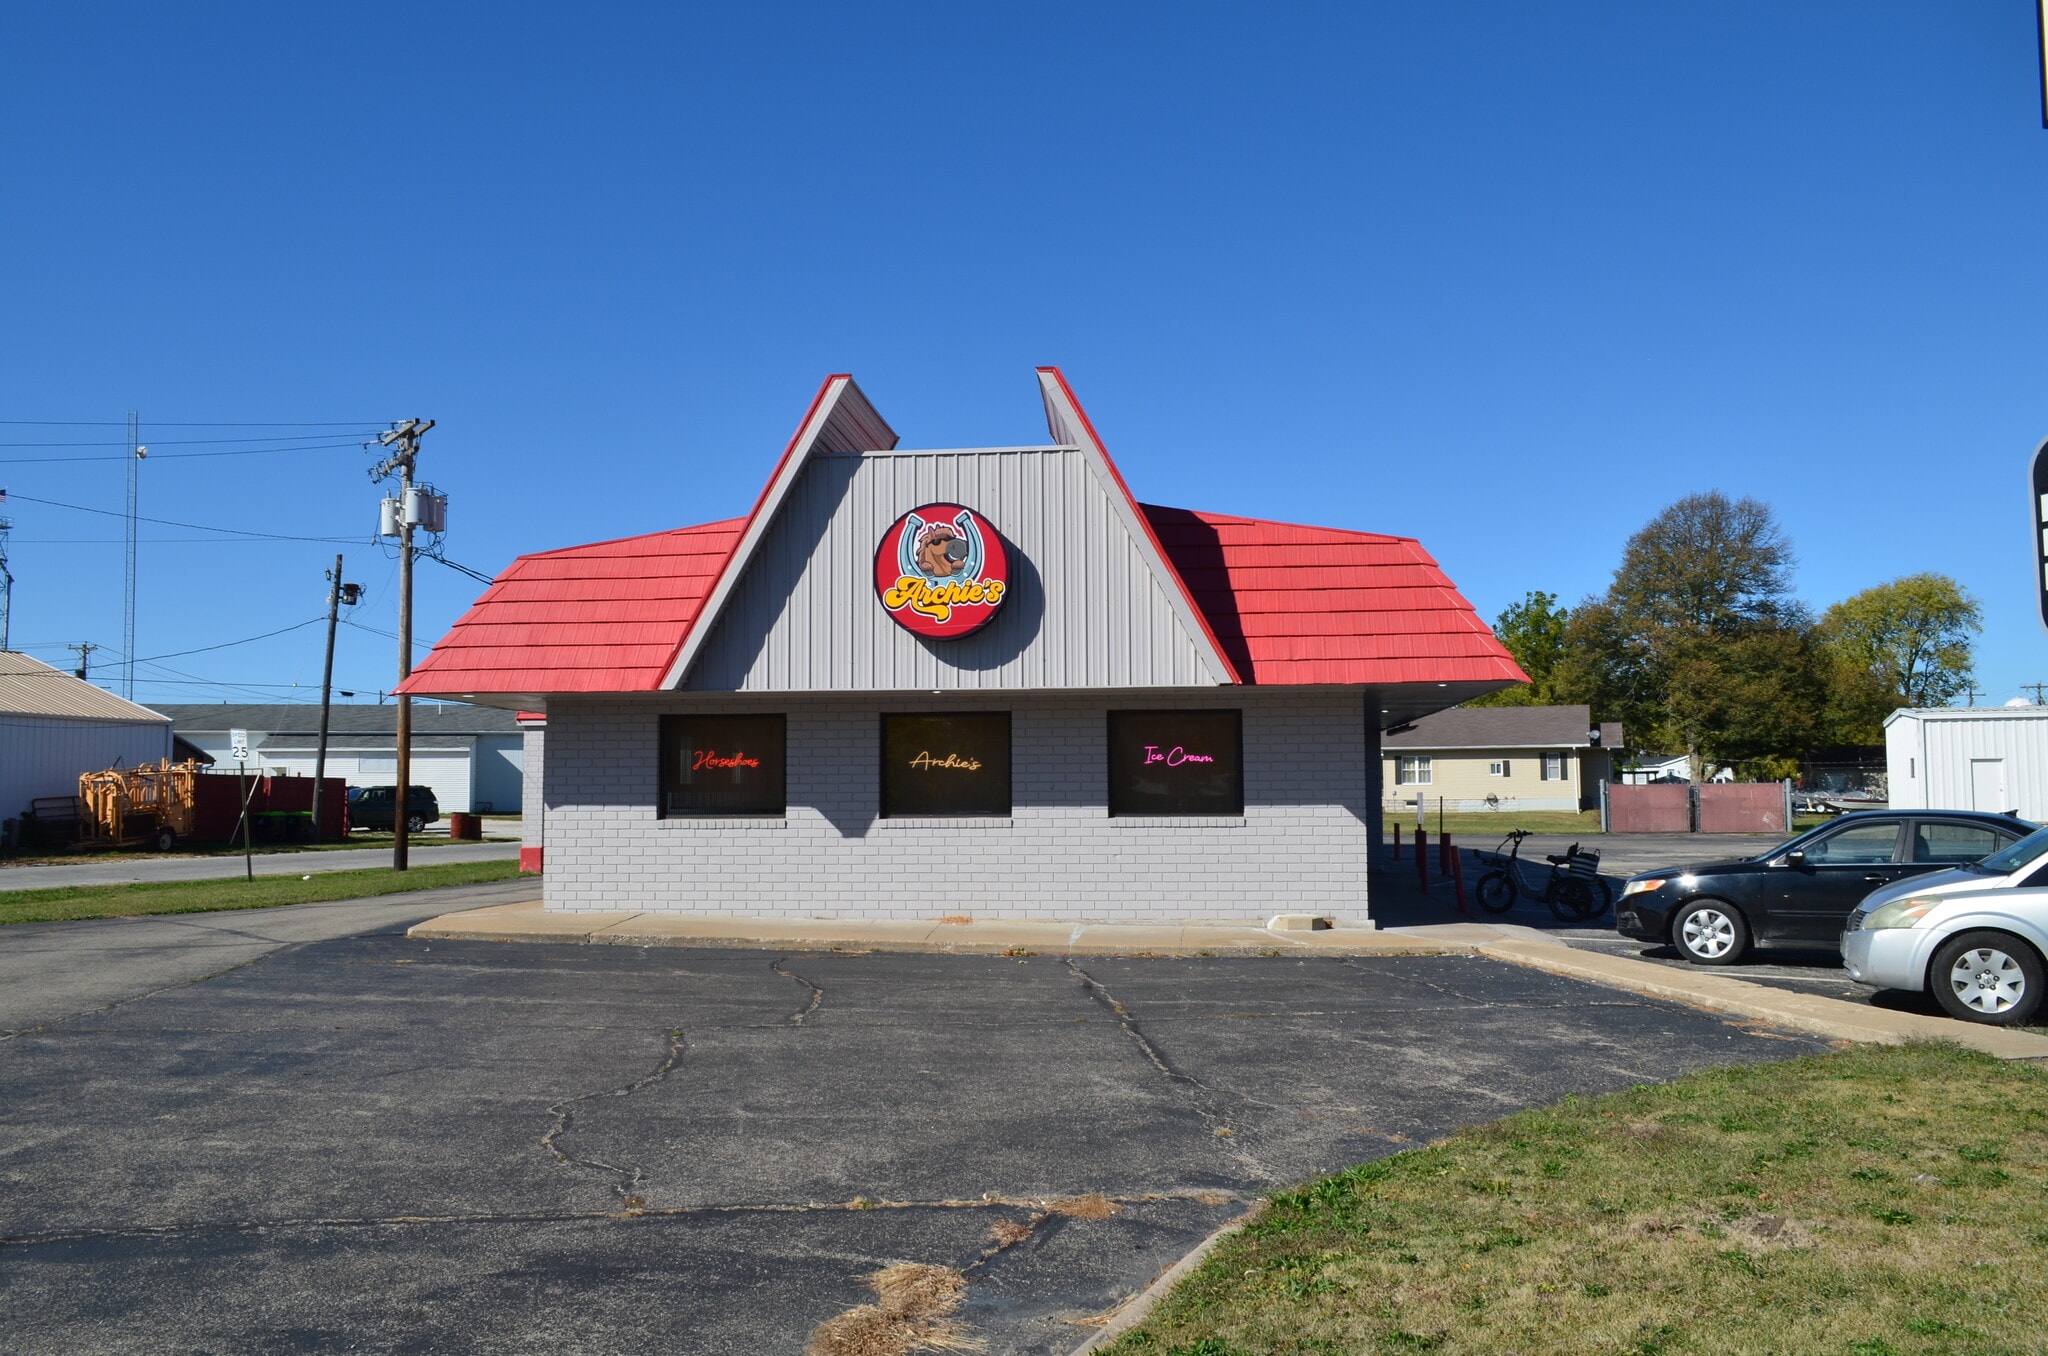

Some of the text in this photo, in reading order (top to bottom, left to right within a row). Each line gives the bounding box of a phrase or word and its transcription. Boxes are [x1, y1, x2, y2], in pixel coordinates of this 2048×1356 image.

[884, 575, 1005, 622] Archie's
[233, 746, 248, 758] 25
[693, 750, 759, 770] Horseshoes
[909, 751, 982, 771] Archie's
[1144, 746, 1214, 767] Ice Cream
